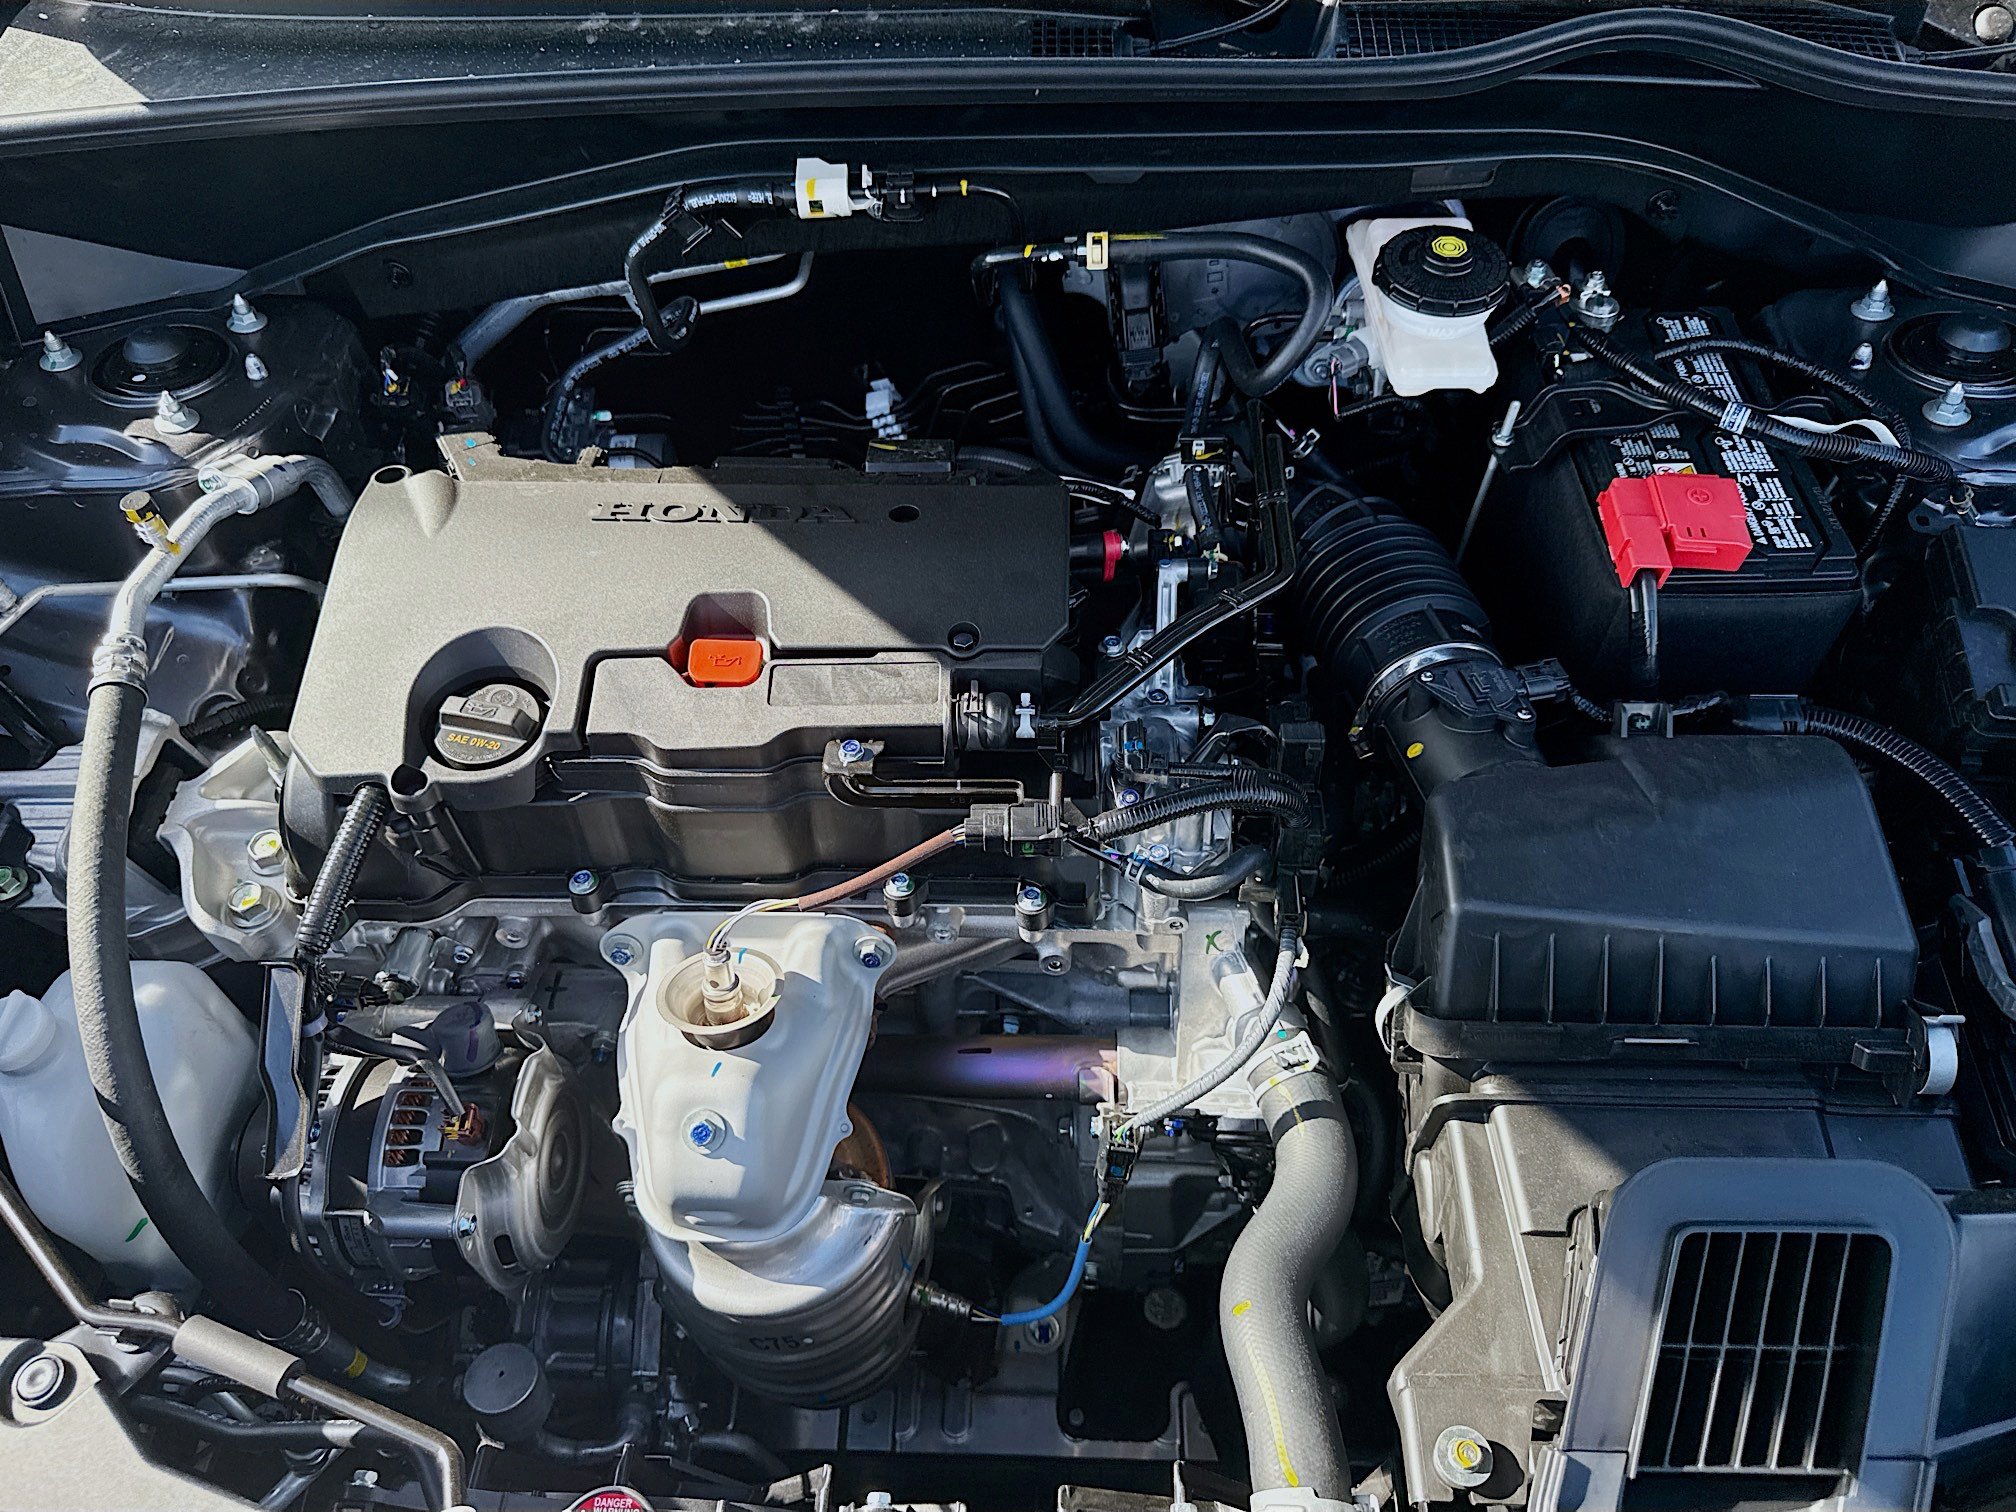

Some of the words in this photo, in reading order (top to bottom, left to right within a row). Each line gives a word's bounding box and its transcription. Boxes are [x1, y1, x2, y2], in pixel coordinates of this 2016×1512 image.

[592, 502, 858, 524] HONDA
[447, 733, 470, 744] SAE
[469, 737, 501, 750] 0W-20
[594, 1497, 633, 1508] DANGER
